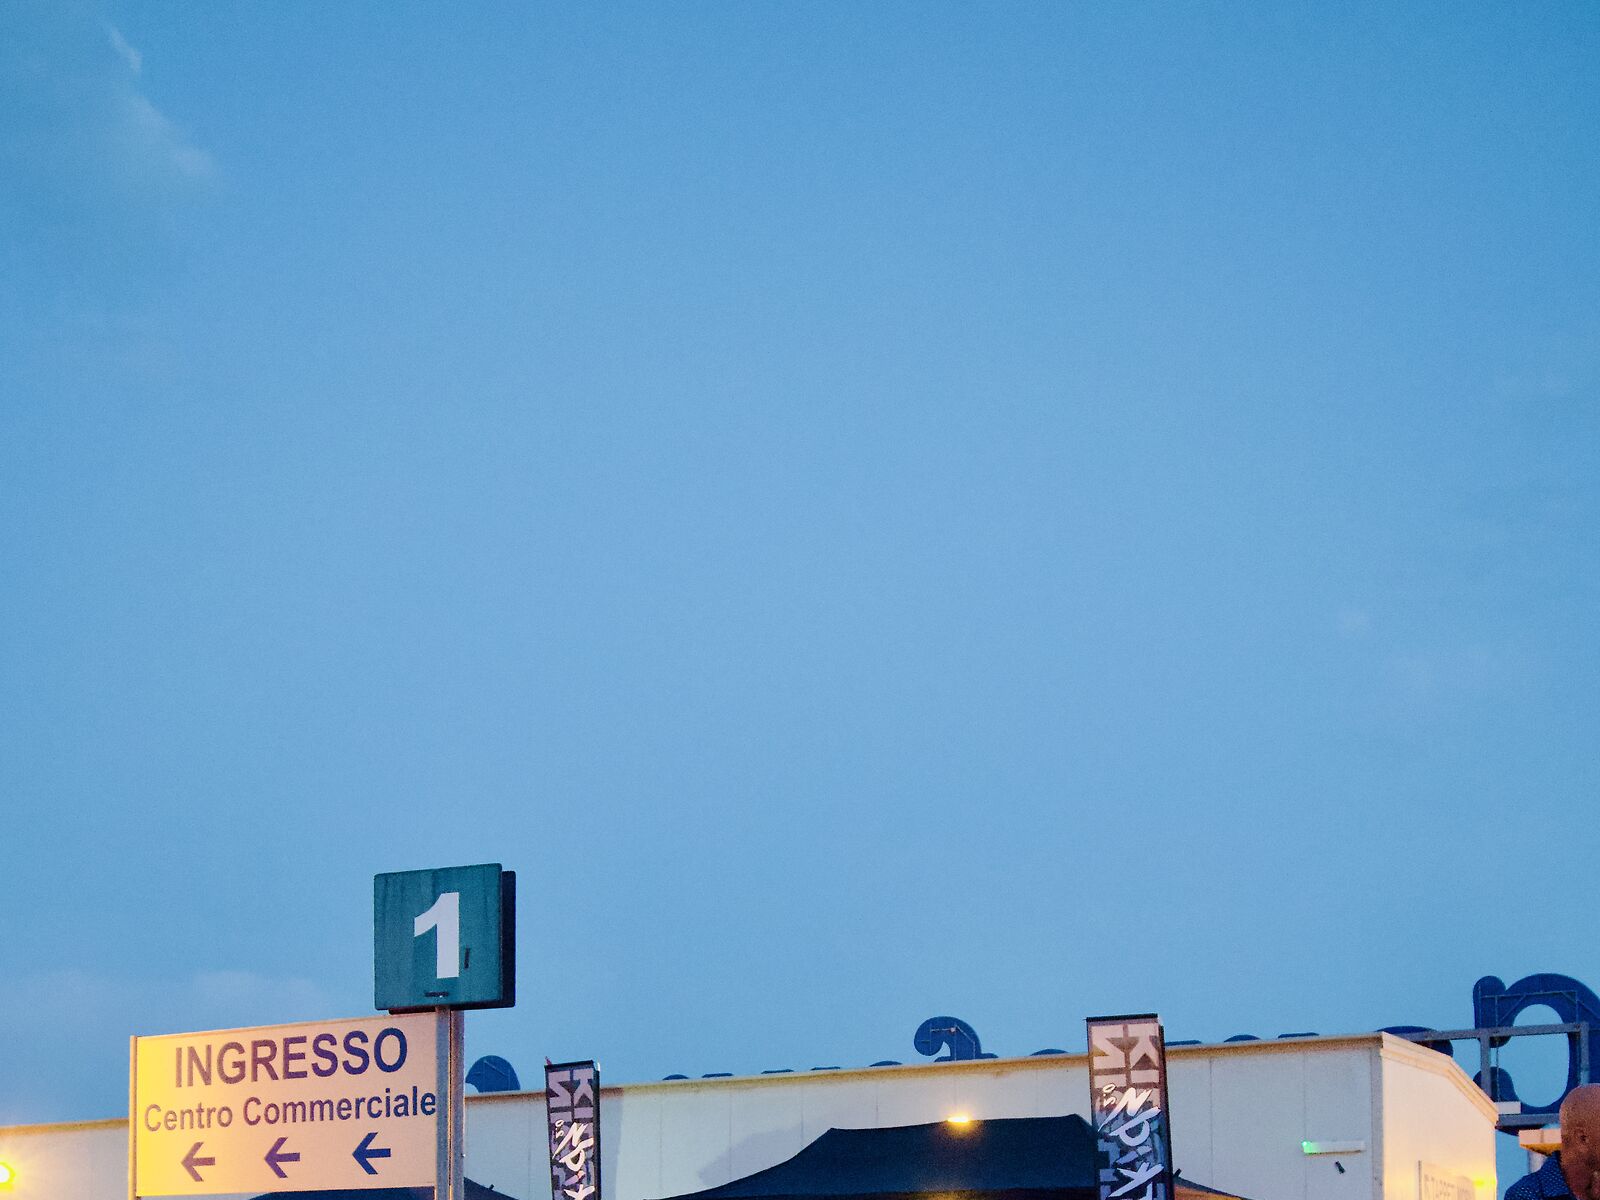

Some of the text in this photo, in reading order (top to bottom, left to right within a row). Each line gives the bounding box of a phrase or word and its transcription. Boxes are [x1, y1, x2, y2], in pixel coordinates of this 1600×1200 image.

[414, 892, 460, 978] 1
[175, 1027, 408, 1088] INGRESSO
[144, 1085, 437, 1132] Centro Commerciale
